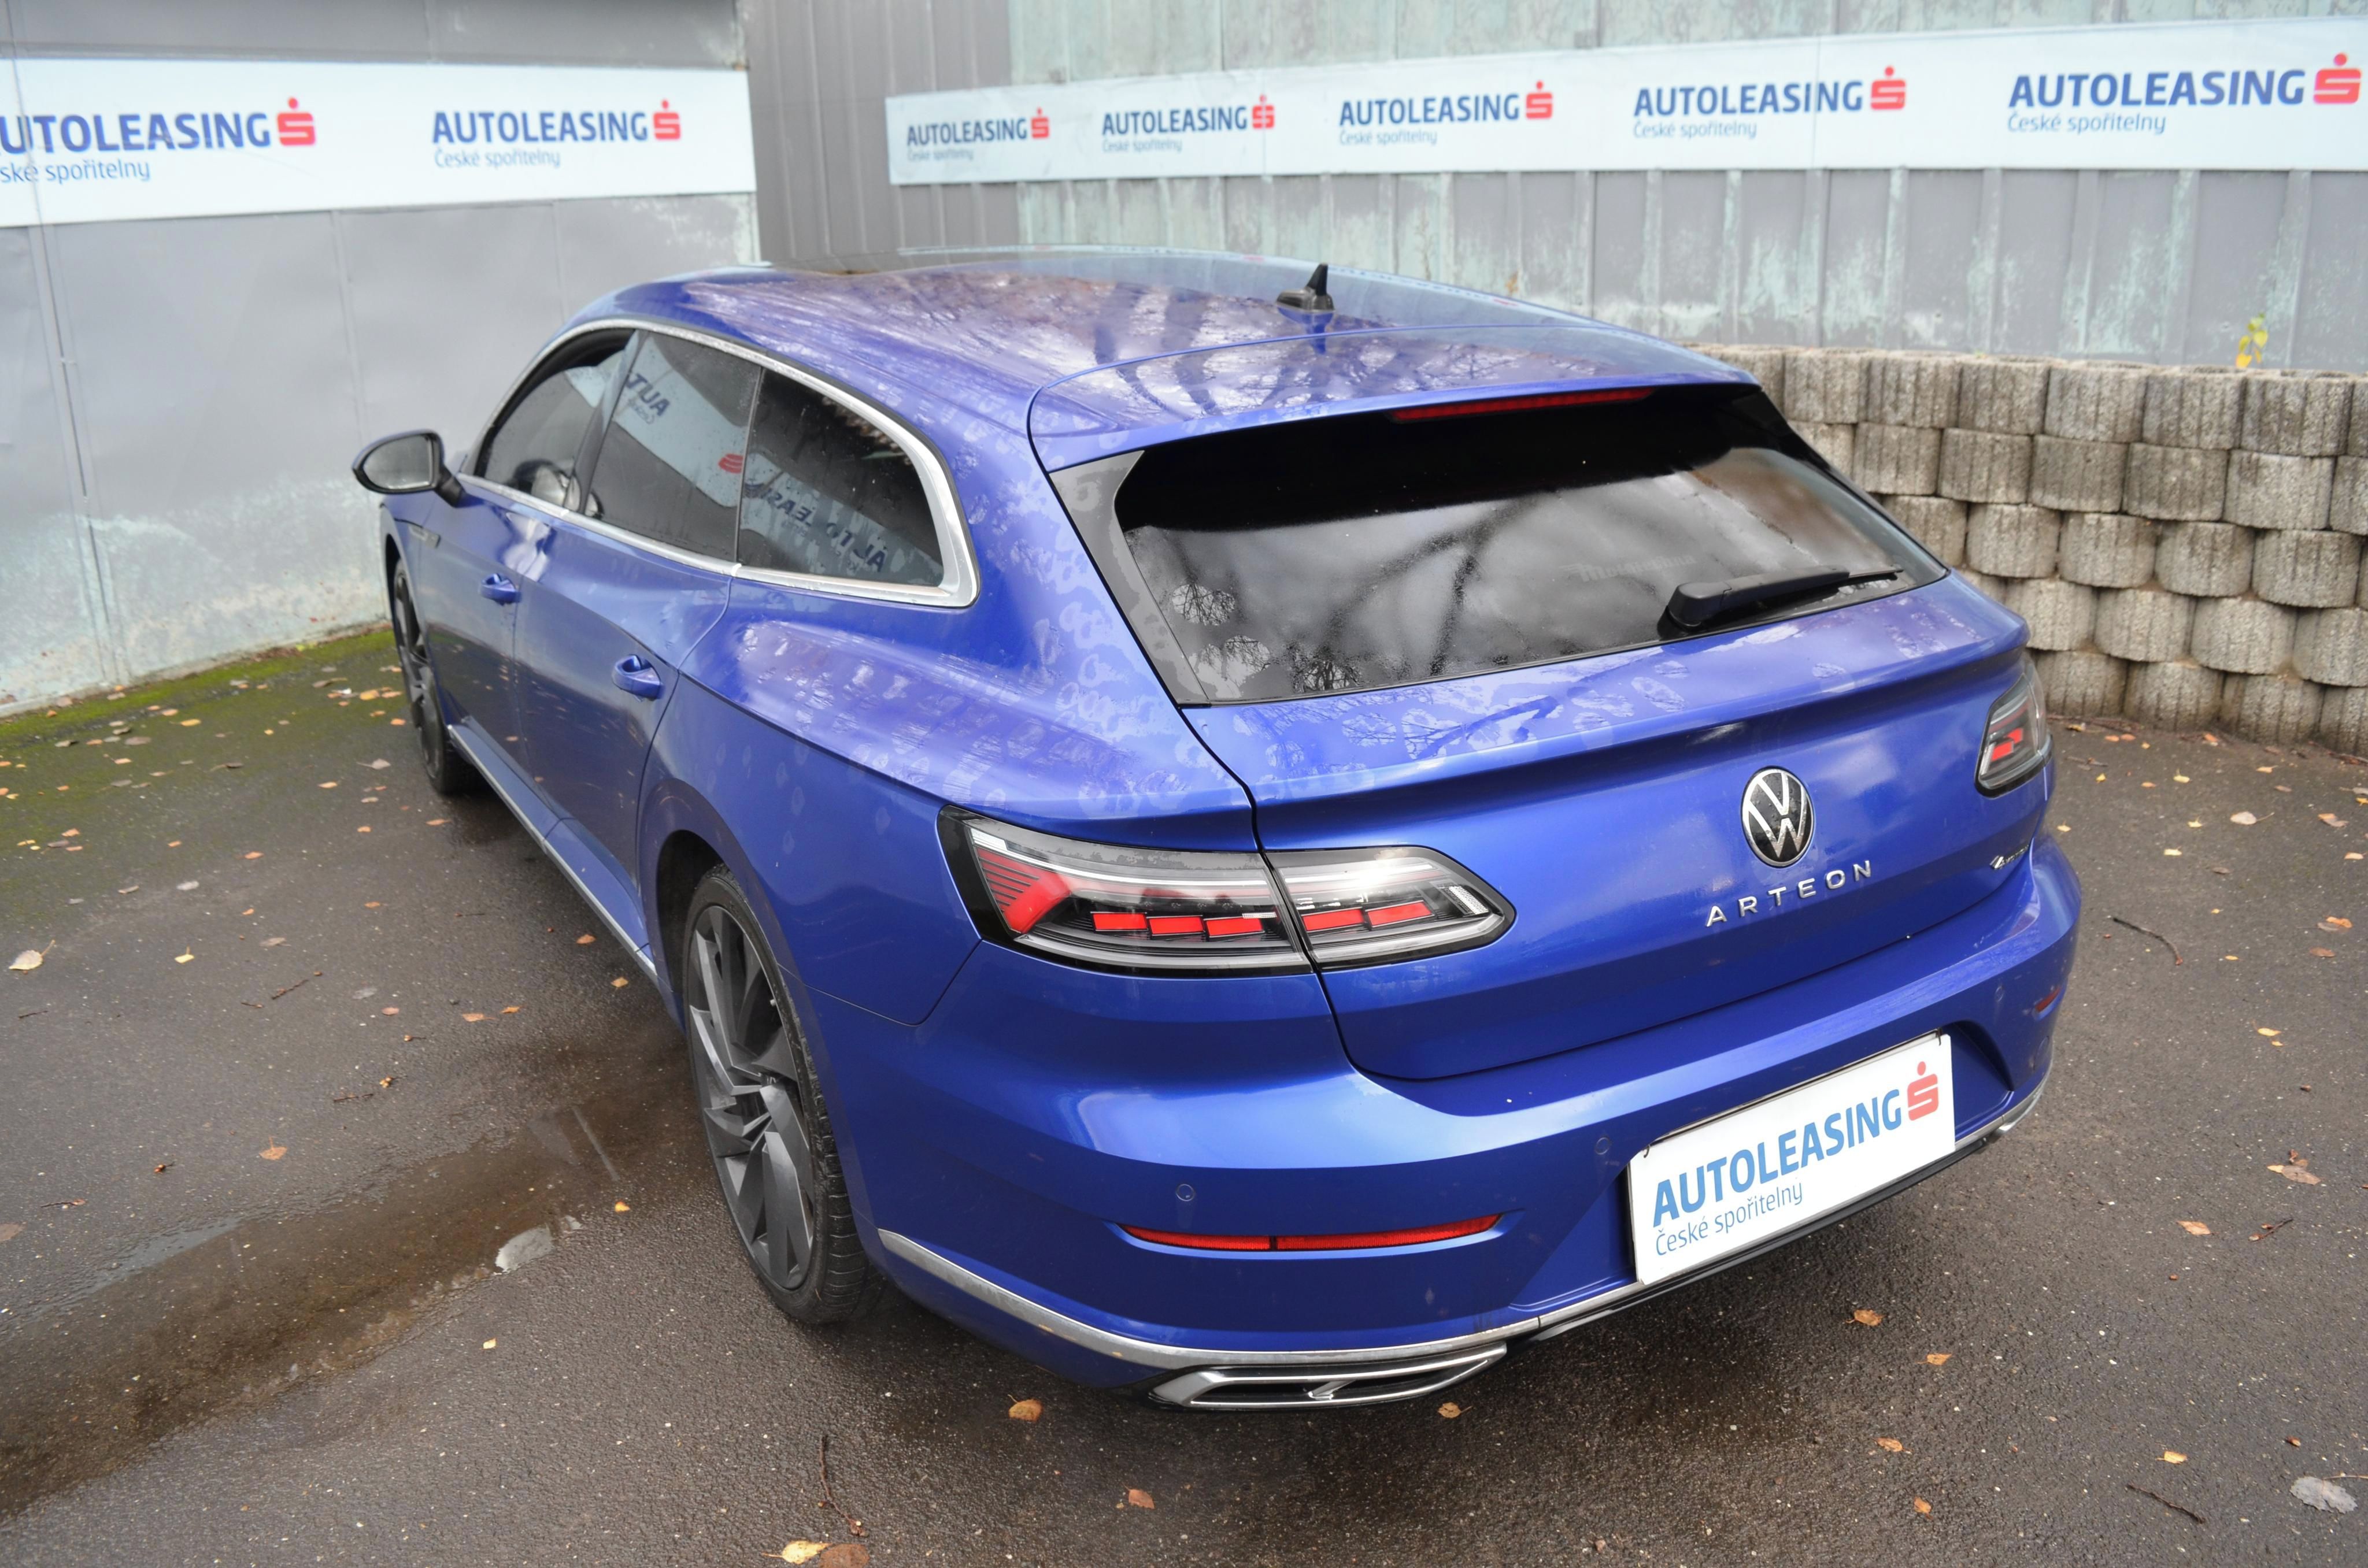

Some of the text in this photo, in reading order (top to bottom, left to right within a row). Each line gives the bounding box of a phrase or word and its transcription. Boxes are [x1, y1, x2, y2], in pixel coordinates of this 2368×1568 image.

[1634, 81, 1863, 116] AUTOLEASING
[2008, 69, 2306, 108] AUTOLEASING
[1102, 106, 1248, 135] AUTOLEASING
[1339, 93, 1519, 126] AUTOLEASING
[2007, 111, 2167, 135] České spořitelny
[0, 113, 271, 155] UTOLEASING
[433, 112, 648, 143] AUTOLEASING
[907, 118, 1027, 146] AUTOLEASING
[1634, 120, 1757, 139] České spořitelny
[0, 158, 151, 185] ské spořitelny
[434, 147, 561, 169] České spořitelny
[1706, 859, 1872, 928] ARTEON
[1653, 1088, 1902, 1229] AUTOLEASING
[1655, 1183, 1804, 1256] České spořitelny
